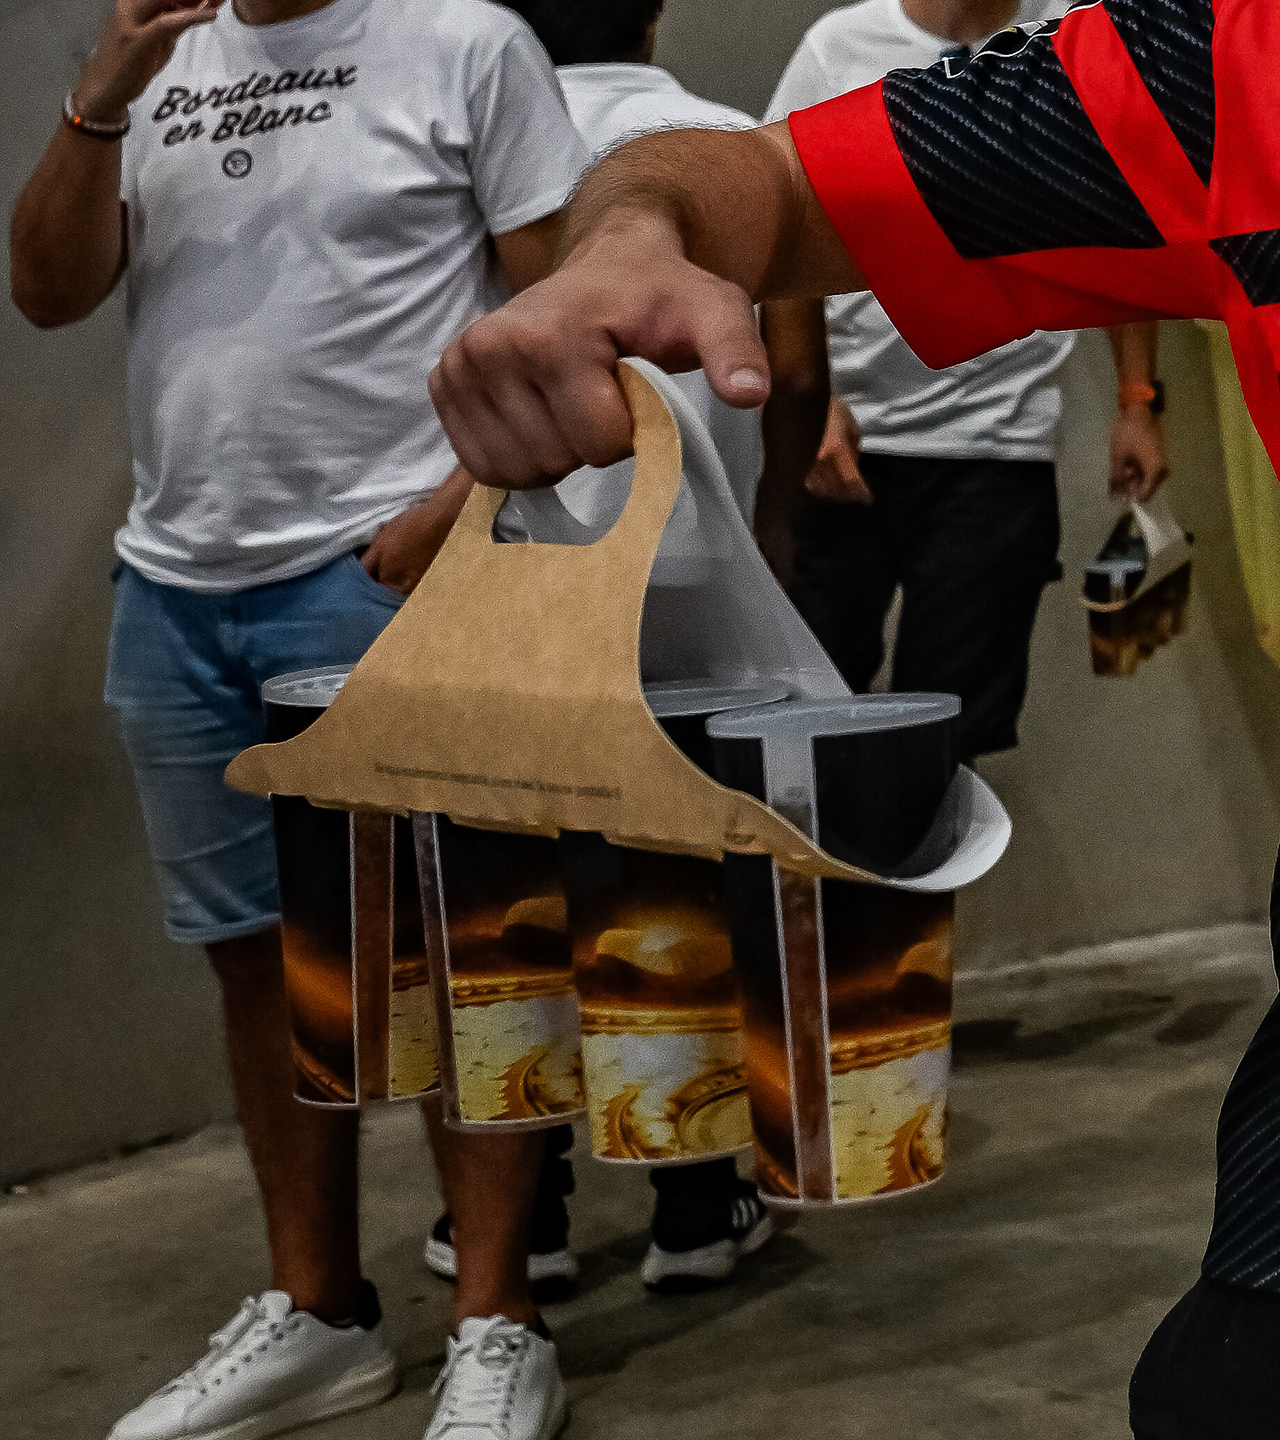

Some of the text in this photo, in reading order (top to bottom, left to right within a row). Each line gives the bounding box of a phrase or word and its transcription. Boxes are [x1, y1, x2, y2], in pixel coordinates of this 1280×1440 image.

[152, 65, 357, 122] Bordeaux
[162, 100, 333, 148] en Blanc
